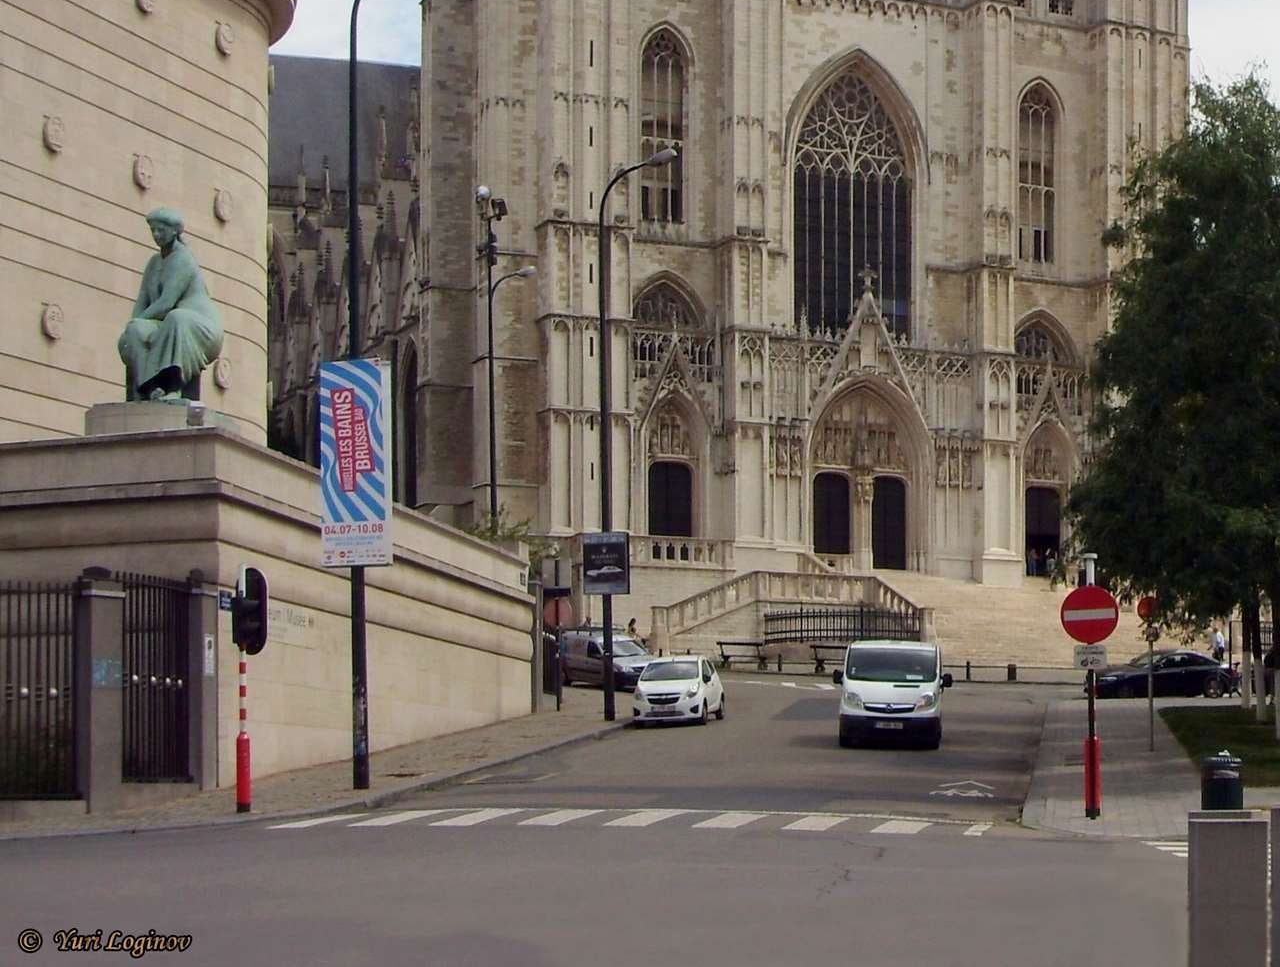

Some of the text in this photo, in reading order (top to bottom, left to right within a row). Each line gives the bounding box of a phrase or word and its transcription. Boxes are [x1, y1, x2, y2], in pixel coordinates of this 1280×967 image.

[333, 390, 354, 491] ELLES LES BAINS
[354, 421, 371, 471] BRUSSEL
